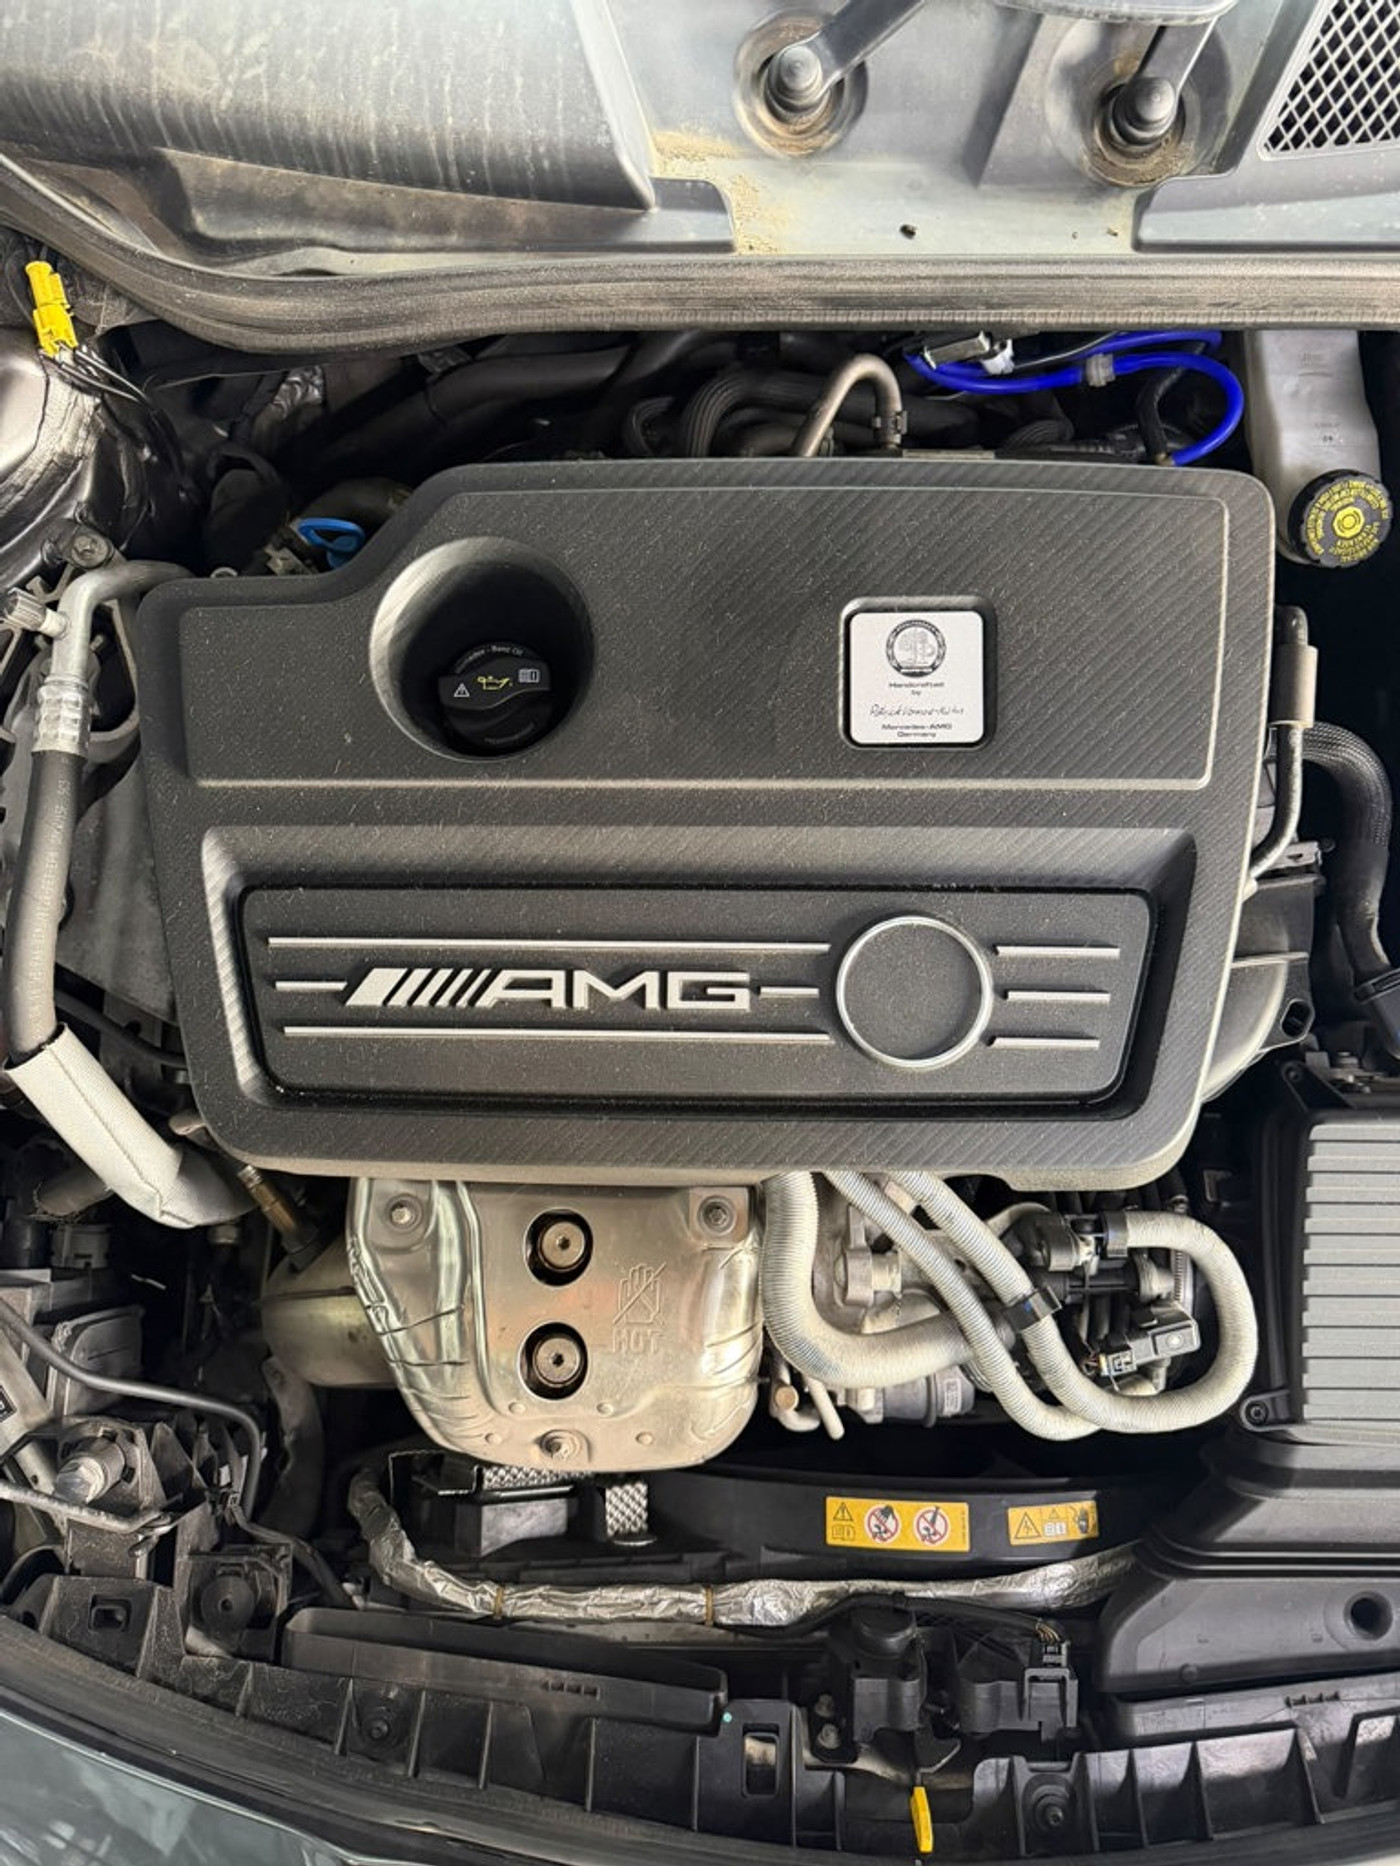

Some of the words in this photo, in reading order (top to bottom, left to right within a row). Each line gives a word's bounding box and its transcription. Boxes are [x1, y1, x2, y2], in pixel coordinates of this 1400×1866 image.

[896, 731, 937, 739] Germany
[473, 968, 751, 1011] AMG
[611, 1327, 666, 1354] HOT
